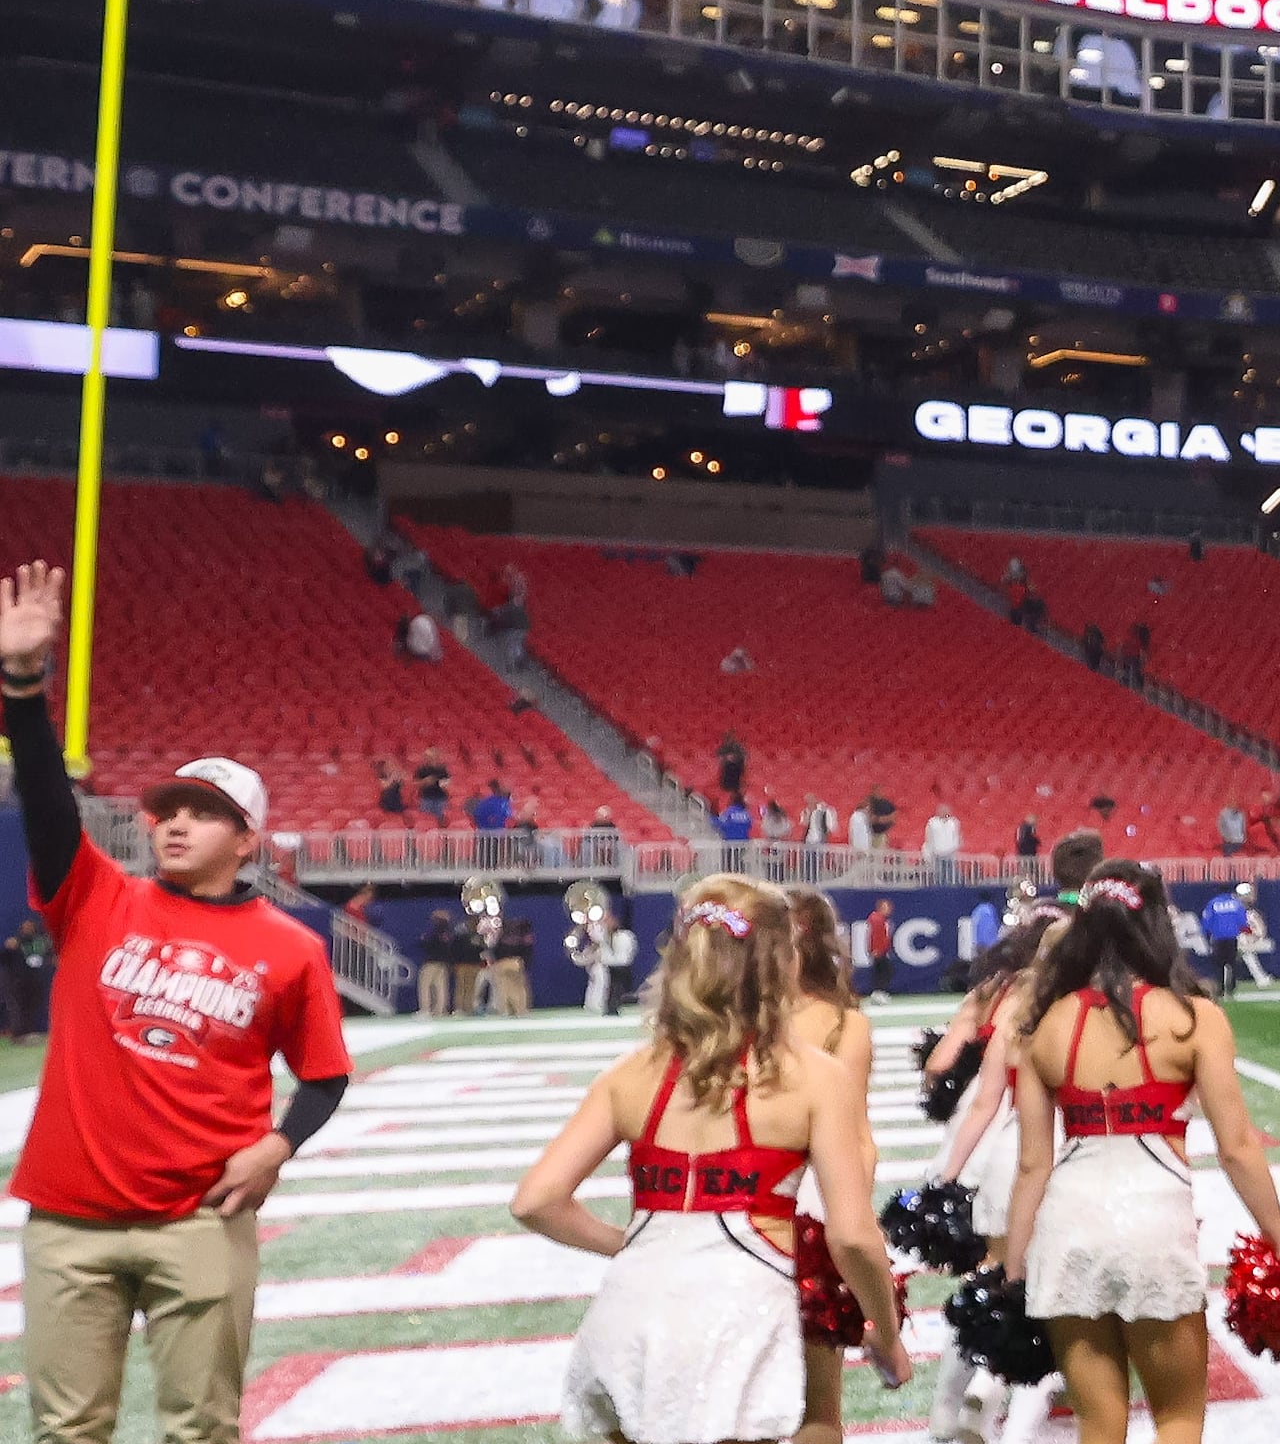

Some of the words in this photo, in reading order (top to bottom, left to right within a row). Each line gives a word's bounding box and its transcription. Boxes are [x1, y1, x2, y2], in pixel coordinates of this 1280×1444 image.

[170, 171, 466, 235] CONFERENCE
[914, 401, 1230, 461] GEORGIA
[101, 948, 262, 1029] CHAMPIONS
